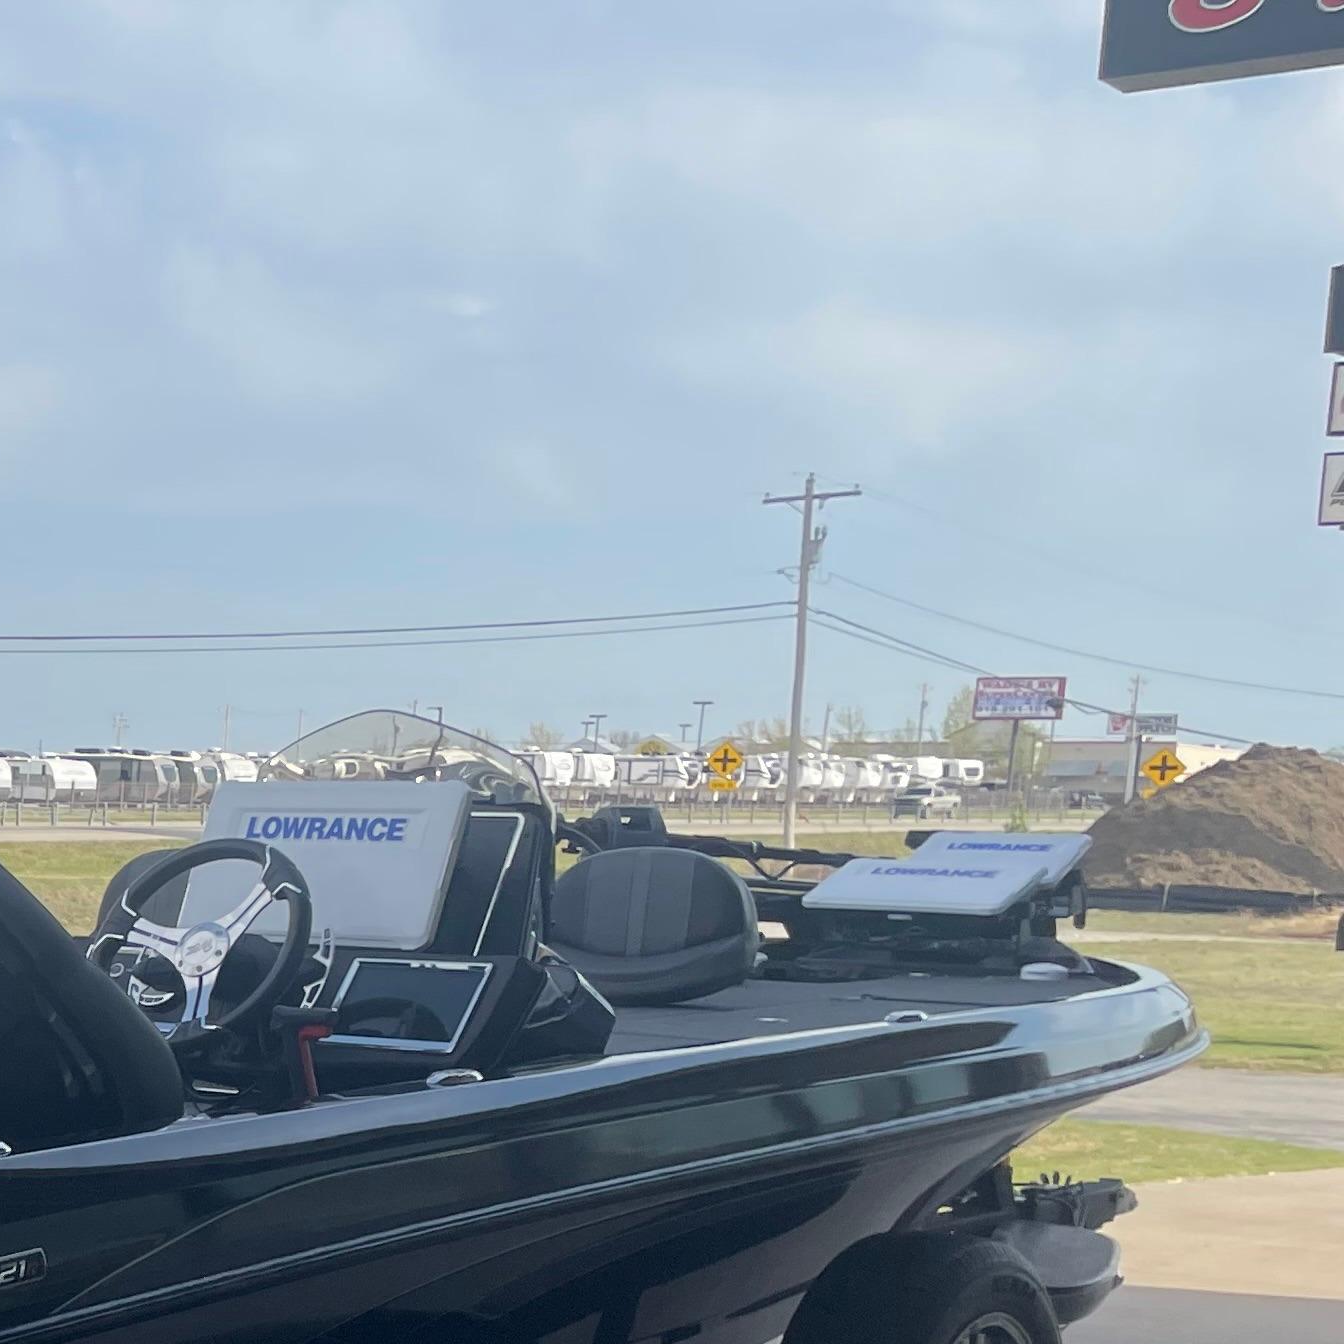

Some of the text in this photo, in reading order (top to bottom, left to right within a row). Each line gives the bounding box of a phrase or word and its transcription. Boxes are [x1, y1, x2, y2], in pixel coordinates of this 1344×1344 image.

[245, 816, 407, 842] LOWRANCE
[947, 843, 1053, 852] LOWRANCE
[871, 867, 1000, 879] LOWRANCE
